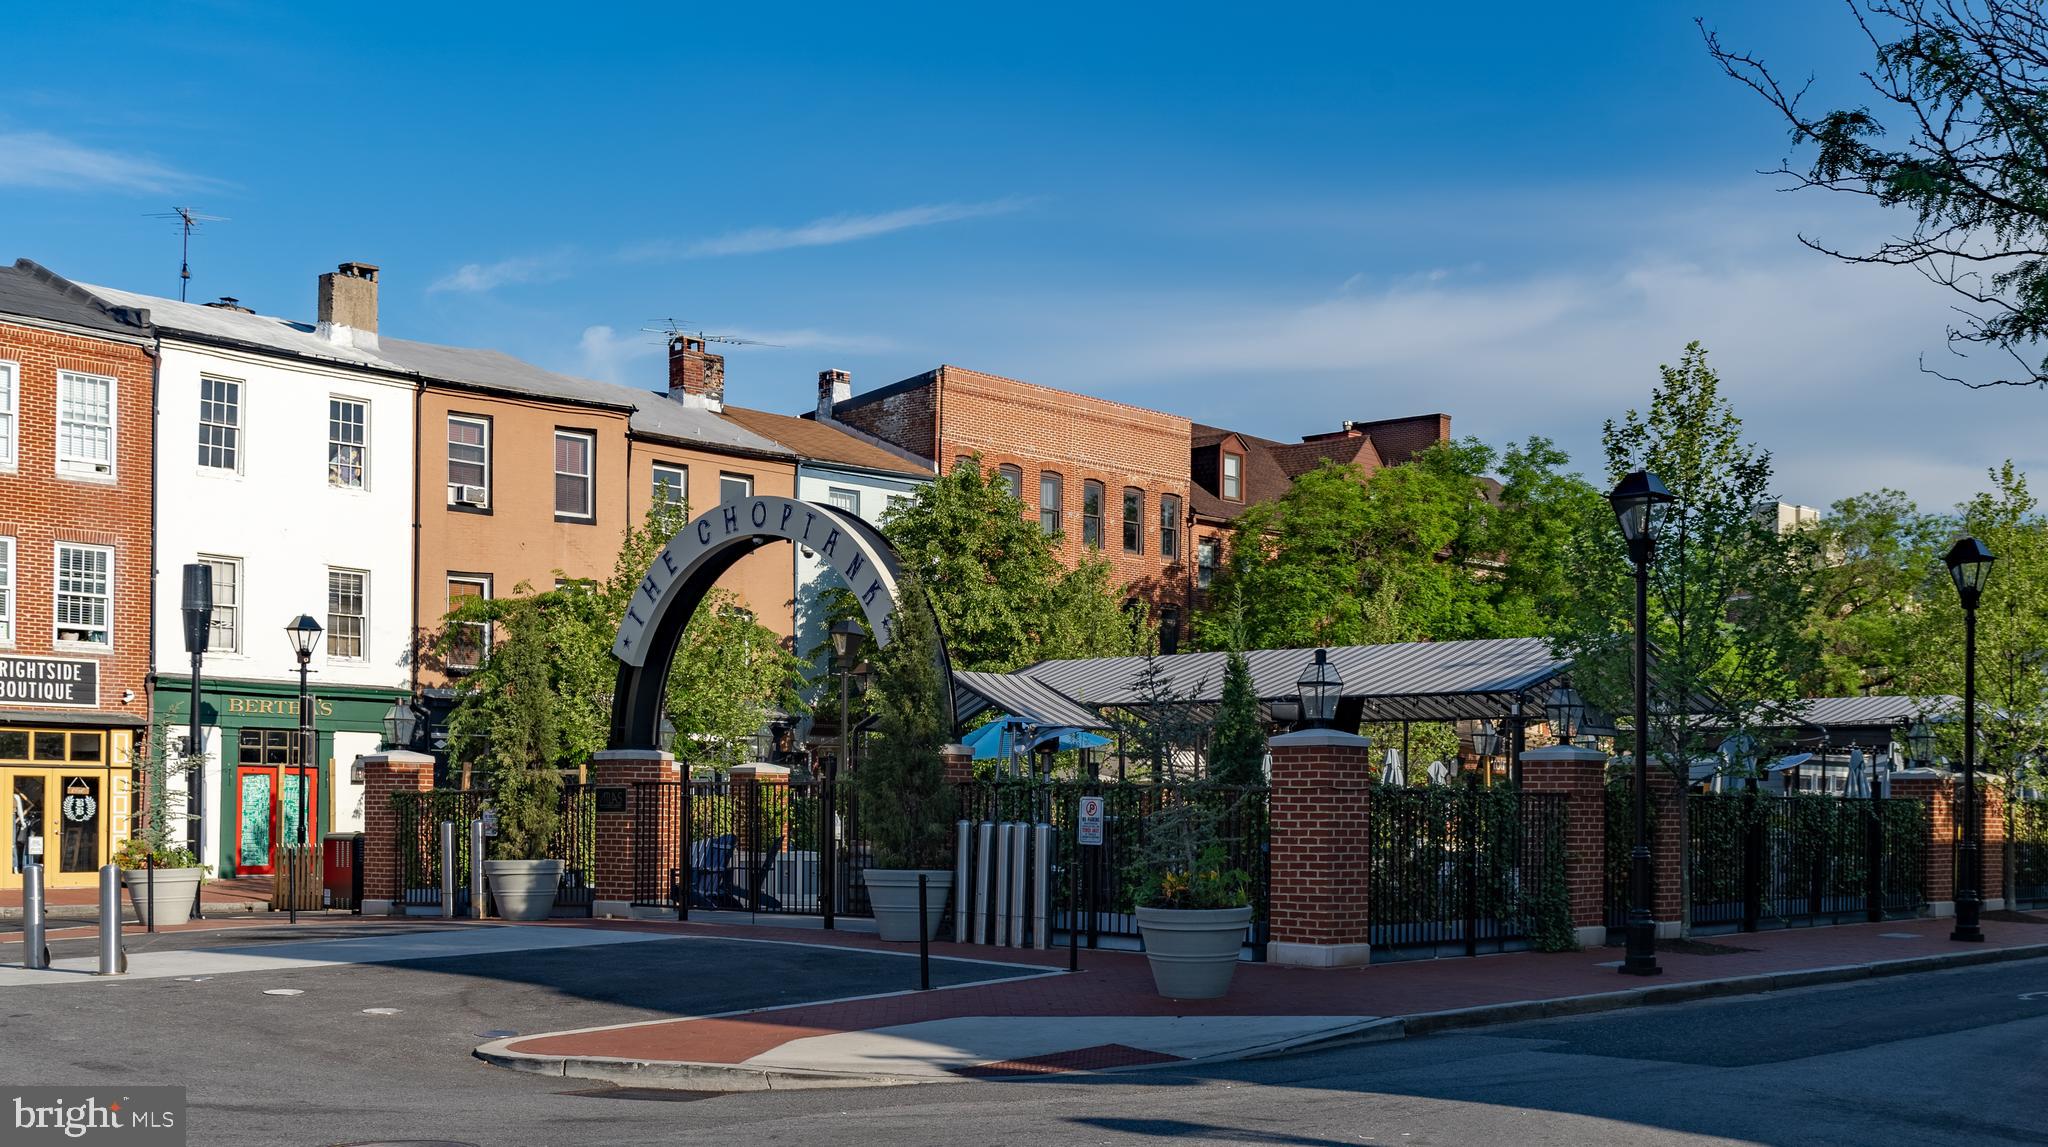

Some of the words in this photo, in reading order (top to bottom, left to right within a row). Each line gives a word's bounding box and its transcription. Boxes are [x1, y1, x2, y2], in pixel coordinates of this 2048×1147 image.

[627, 550, 679, 628] THE
[697, 501, 886, 607] CHOPTANK
[0, 660, 82, 681] RIGHTSIDE
[0, 680, 74, 701] BOUTIQUE
[228, 697, 333, 716] BERTH'S
